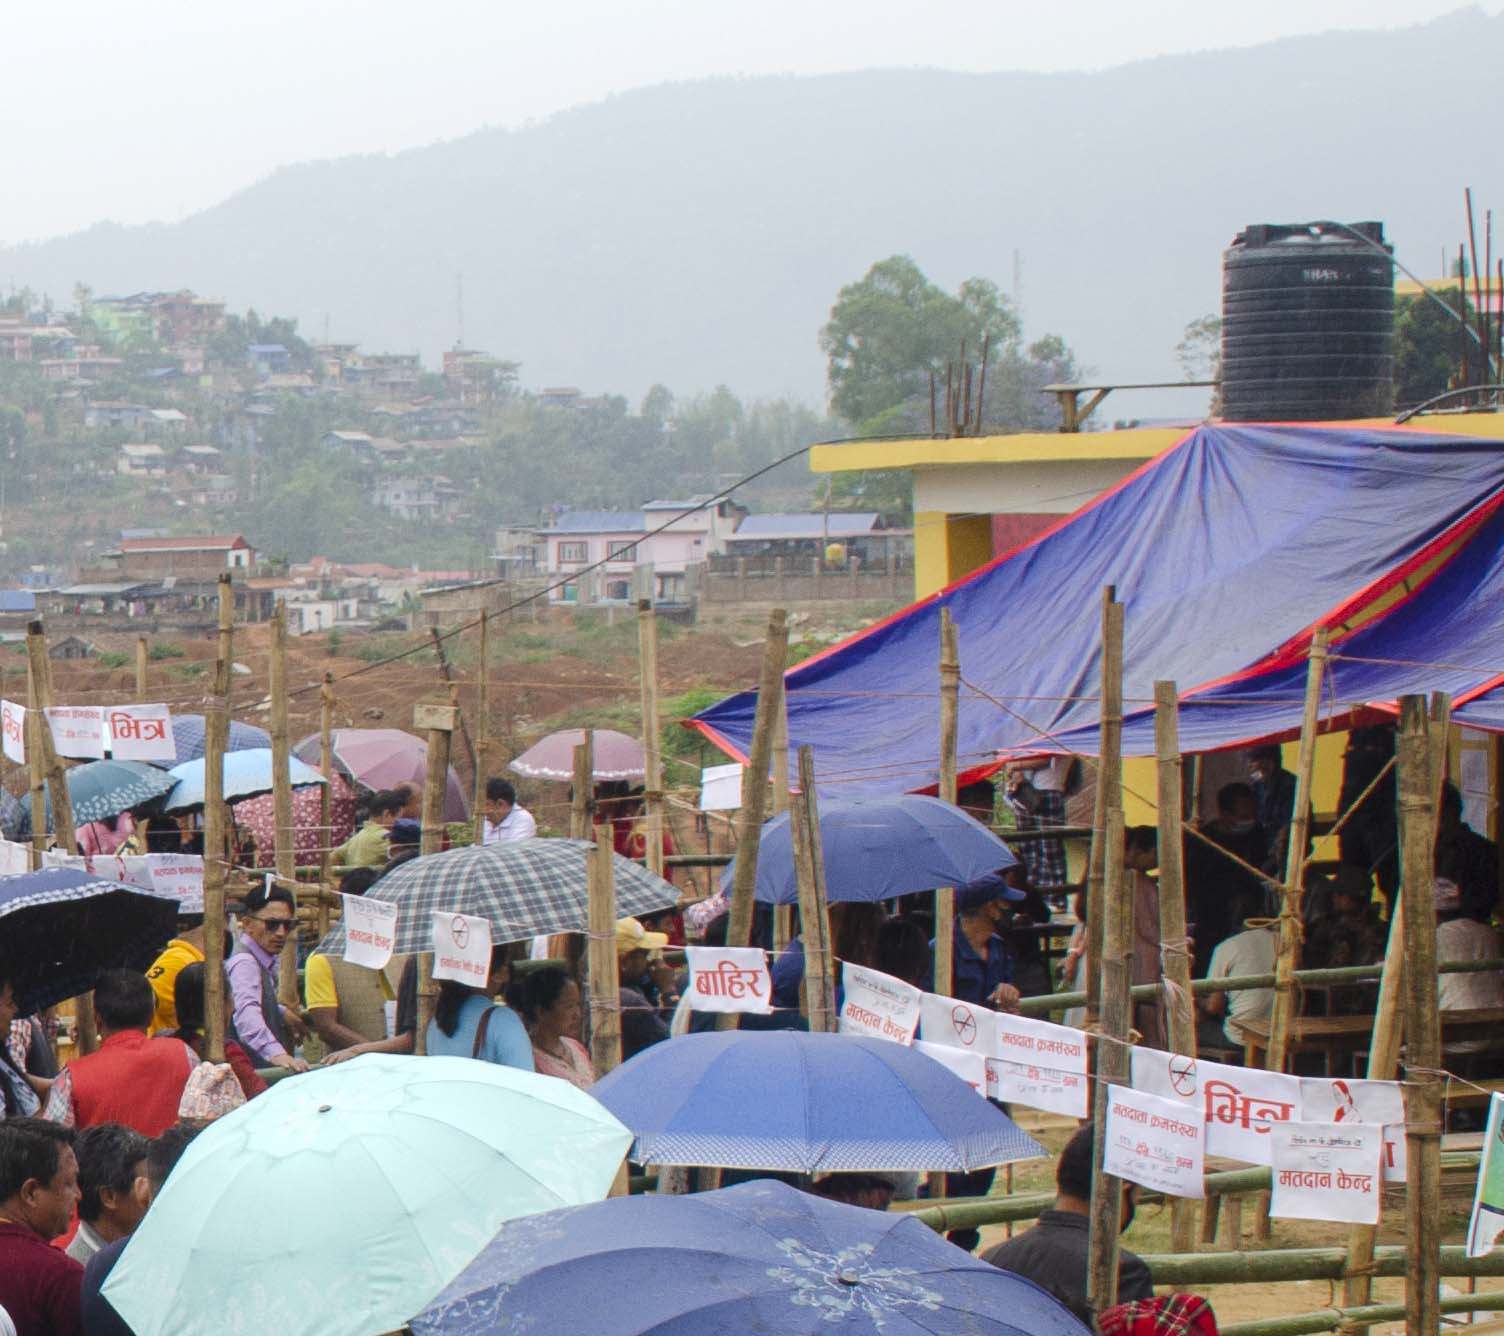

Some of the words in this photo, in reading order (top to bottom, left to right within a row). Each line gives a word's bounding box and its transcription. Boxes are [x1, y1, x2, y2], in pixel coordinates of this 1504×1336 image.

[111, 711, 167, 740] भित्र
[696, 960, 763, 998] बाहिर
[846, 1001, 881, 1028] मतदान
[883, 1015, 911, 1043] केन्द्र
[1002, 1031, 1034, 1049] मतदाता
[1036, 1038, 1081, 1056] क्रमसंख्या
[1113, 1103, 1147, 1124] मतदाता
[1150, 1114, 1198, 1138] क्रमसंख्या
[1204, 1080, 1295, 1133] भित्र
[1279, 1169, 1332, 1189] मतदान
[1337, 1167, 1373, 1193] केन्द्र
